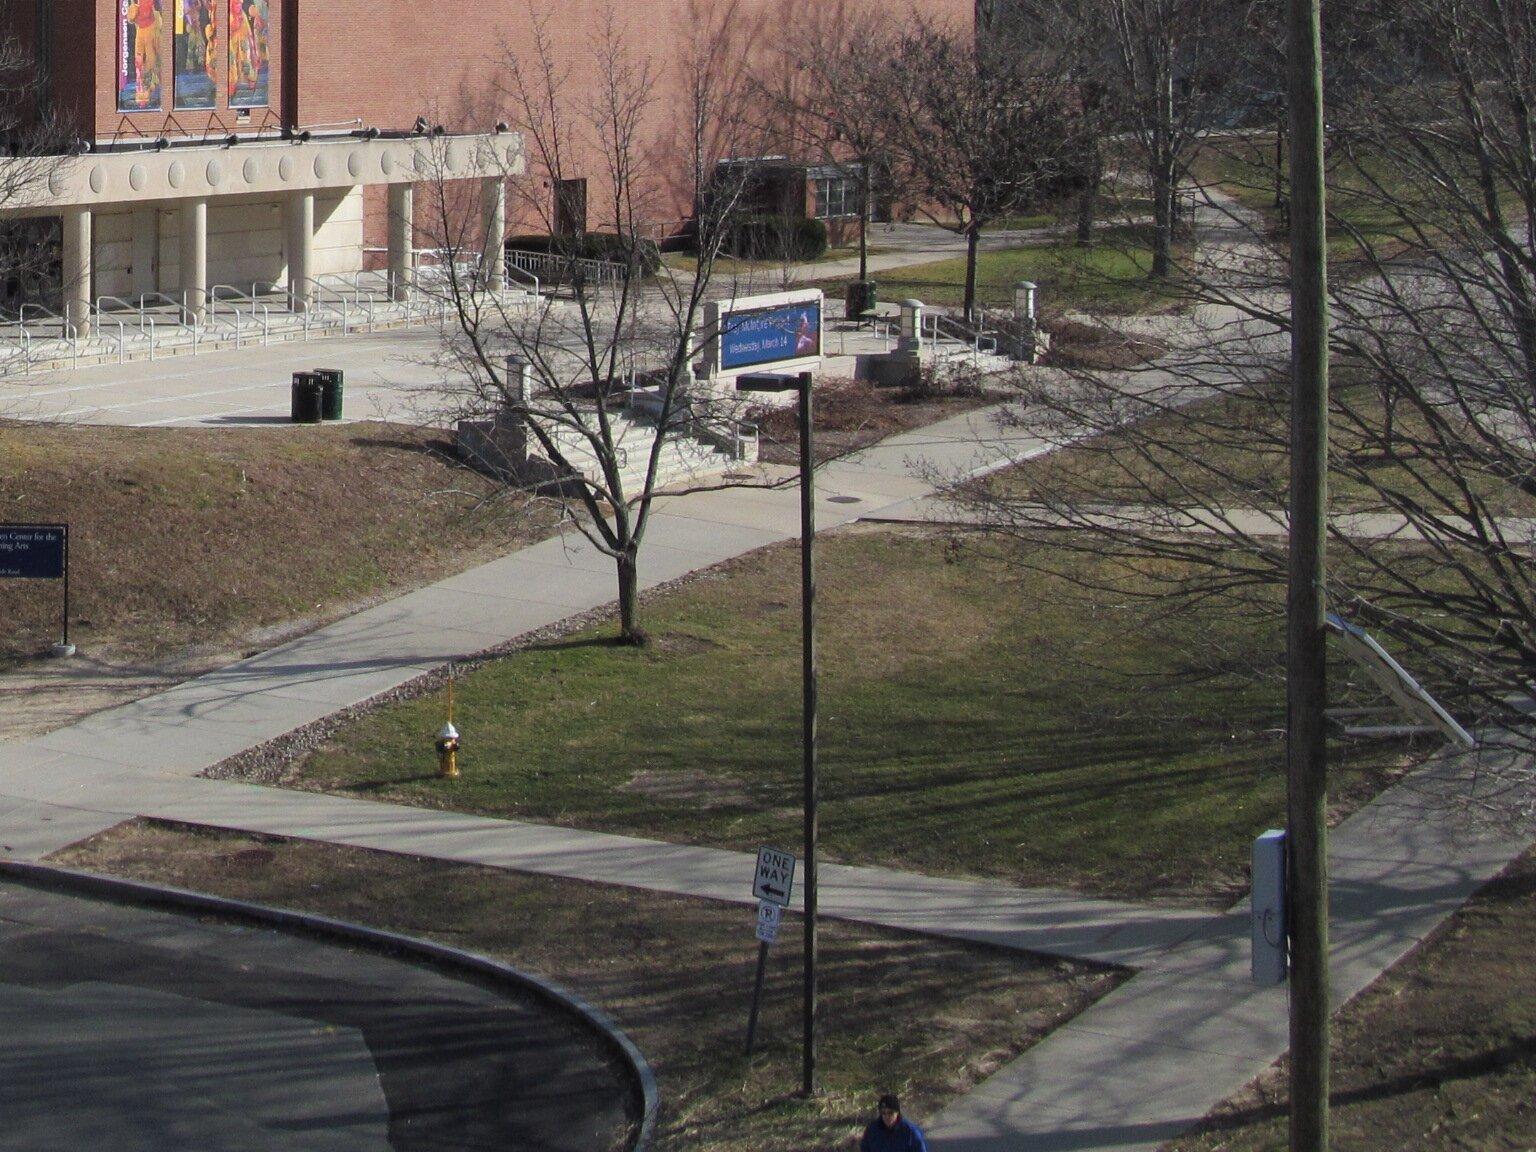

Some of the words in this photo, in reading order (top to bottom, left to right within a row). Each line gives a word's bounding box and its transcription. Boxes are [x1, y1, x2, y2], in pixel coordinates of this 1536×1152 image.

[762, 338, 779, 349] March
[780, 336, 788, 347] 14
[9, 532, 32, 541] Center
[34, 532, 43, 541] for
[45, 532, 57, 541] the
[15, 542, 29, 550] Arts
[763, 852, 789, 870] ONE
[760, 866, 790, 884] WAY
